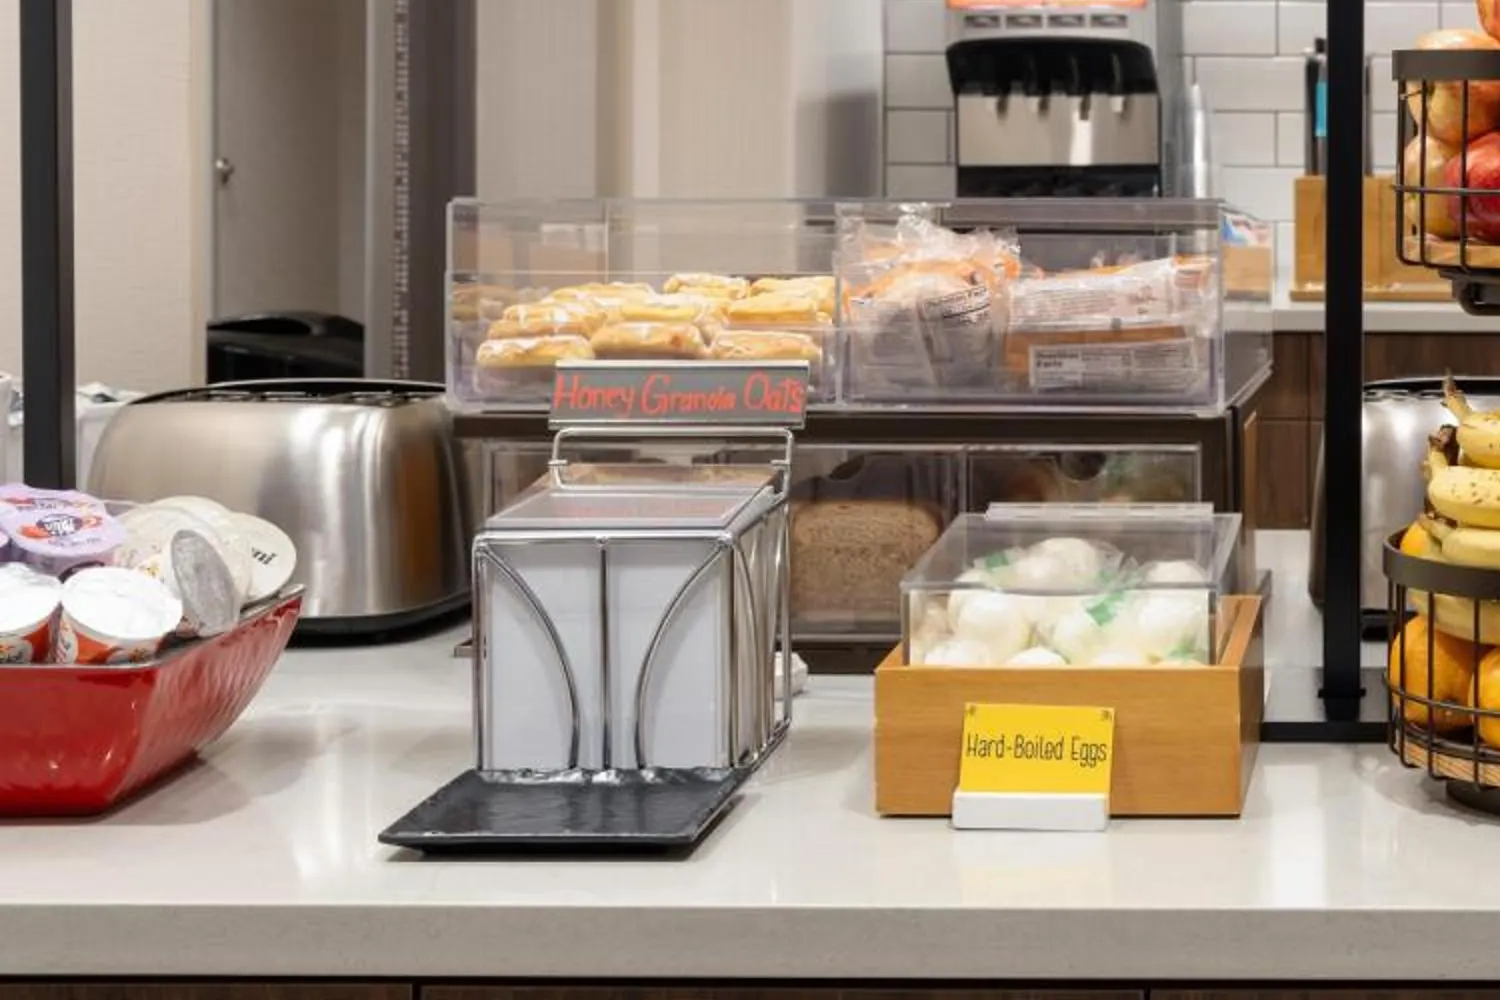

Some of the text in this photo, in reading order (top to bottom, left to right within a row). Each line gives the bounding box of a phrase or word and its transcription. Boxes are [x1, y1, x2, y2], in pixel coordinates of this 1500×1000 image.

[552, 373, 634, 418] Honey
[966, 733, 1109, 769] Hard-Boiled Eggs
